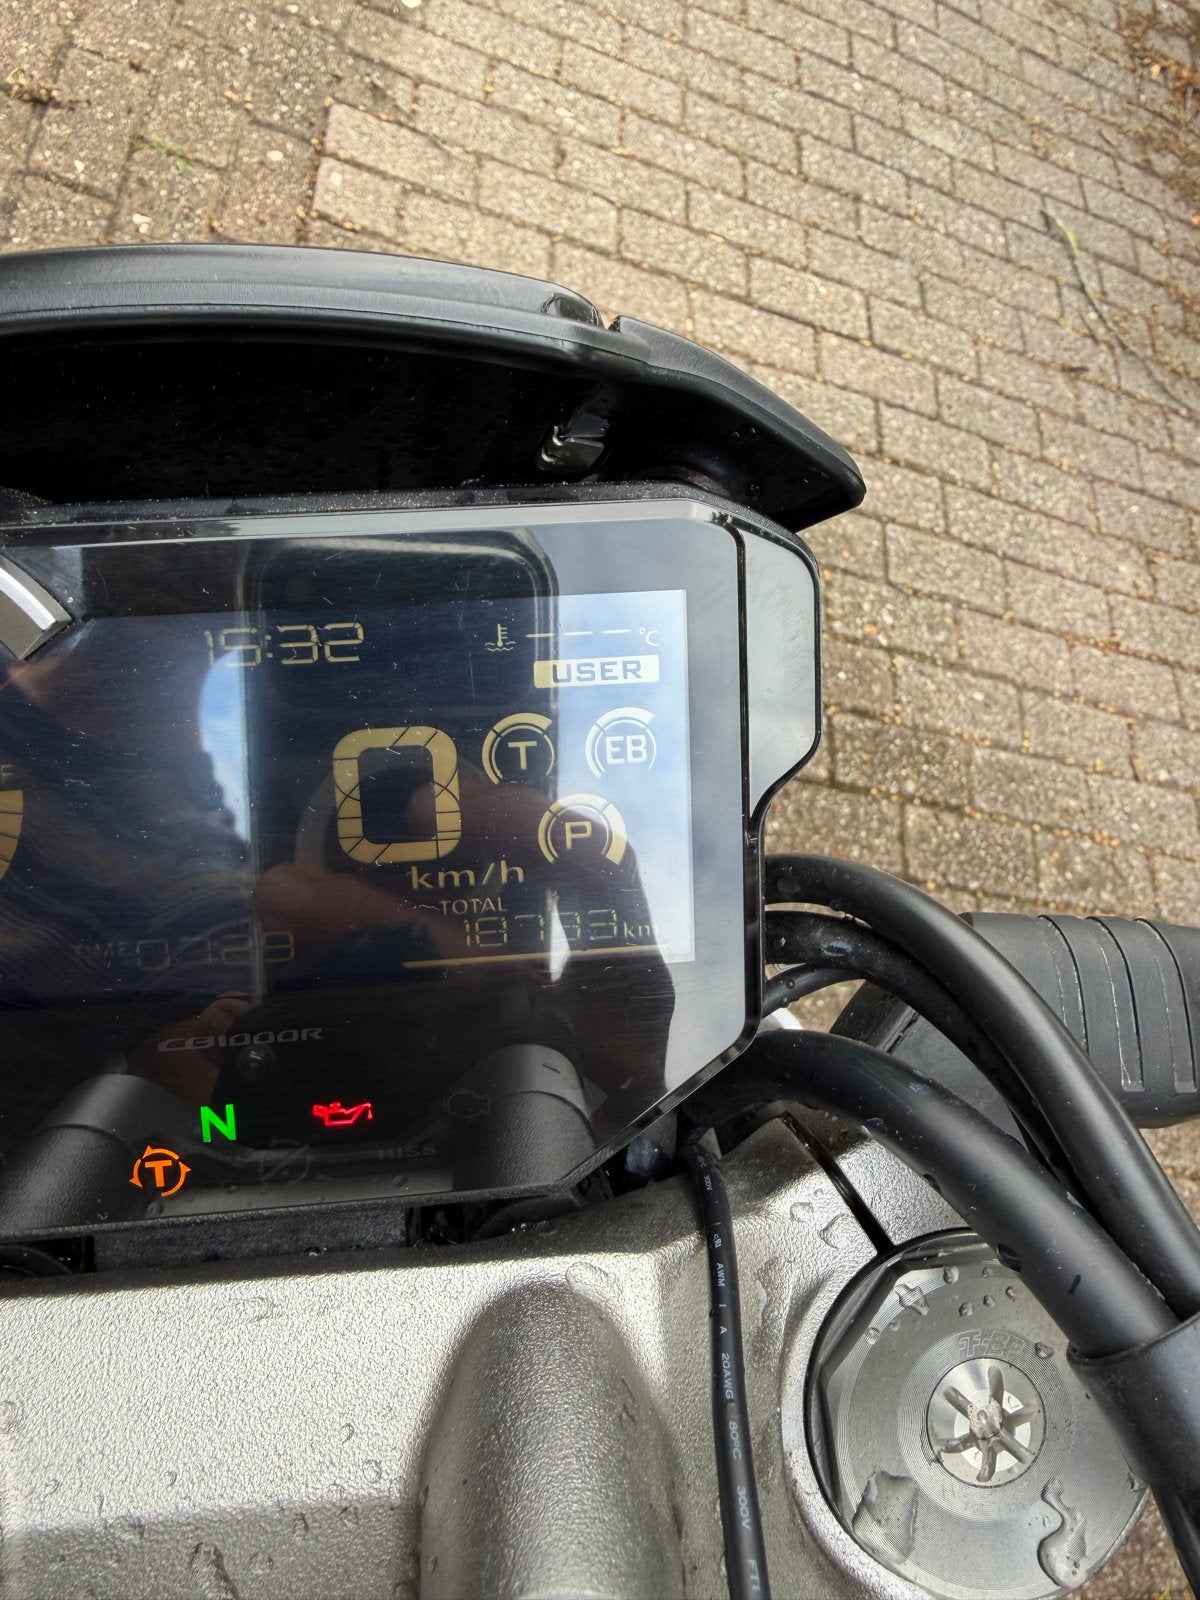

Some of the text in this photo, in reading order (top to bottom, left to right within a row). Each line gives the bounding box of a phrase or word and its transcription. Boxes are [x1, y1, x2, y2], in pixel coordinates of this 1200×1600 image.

[204, 622, 364, 667] 15:32
[552, 659, 642, 683] USER
[508, 740, 537, 770] T
[606, 734, 648, 765] EB
[332, 725, 462, 864] 0
[564, 821, 592, 849] P
[411, 860, 525, 890] km/h
[440, 896, 508, 916] TOTAL
[157, 1027, 324, 1050] CB1000R
[200, 1103, 237, 1143] N
[378, 1144, 438, 1161] HISS
[145, 1159, 172, 1188] T
[716, 1262, 726, 1287] AWM
[719, 1325, 728, 1336] A
[721, 1352, 734, 1400] 20AWG
[737, 1484, 751, 1531] 300V
